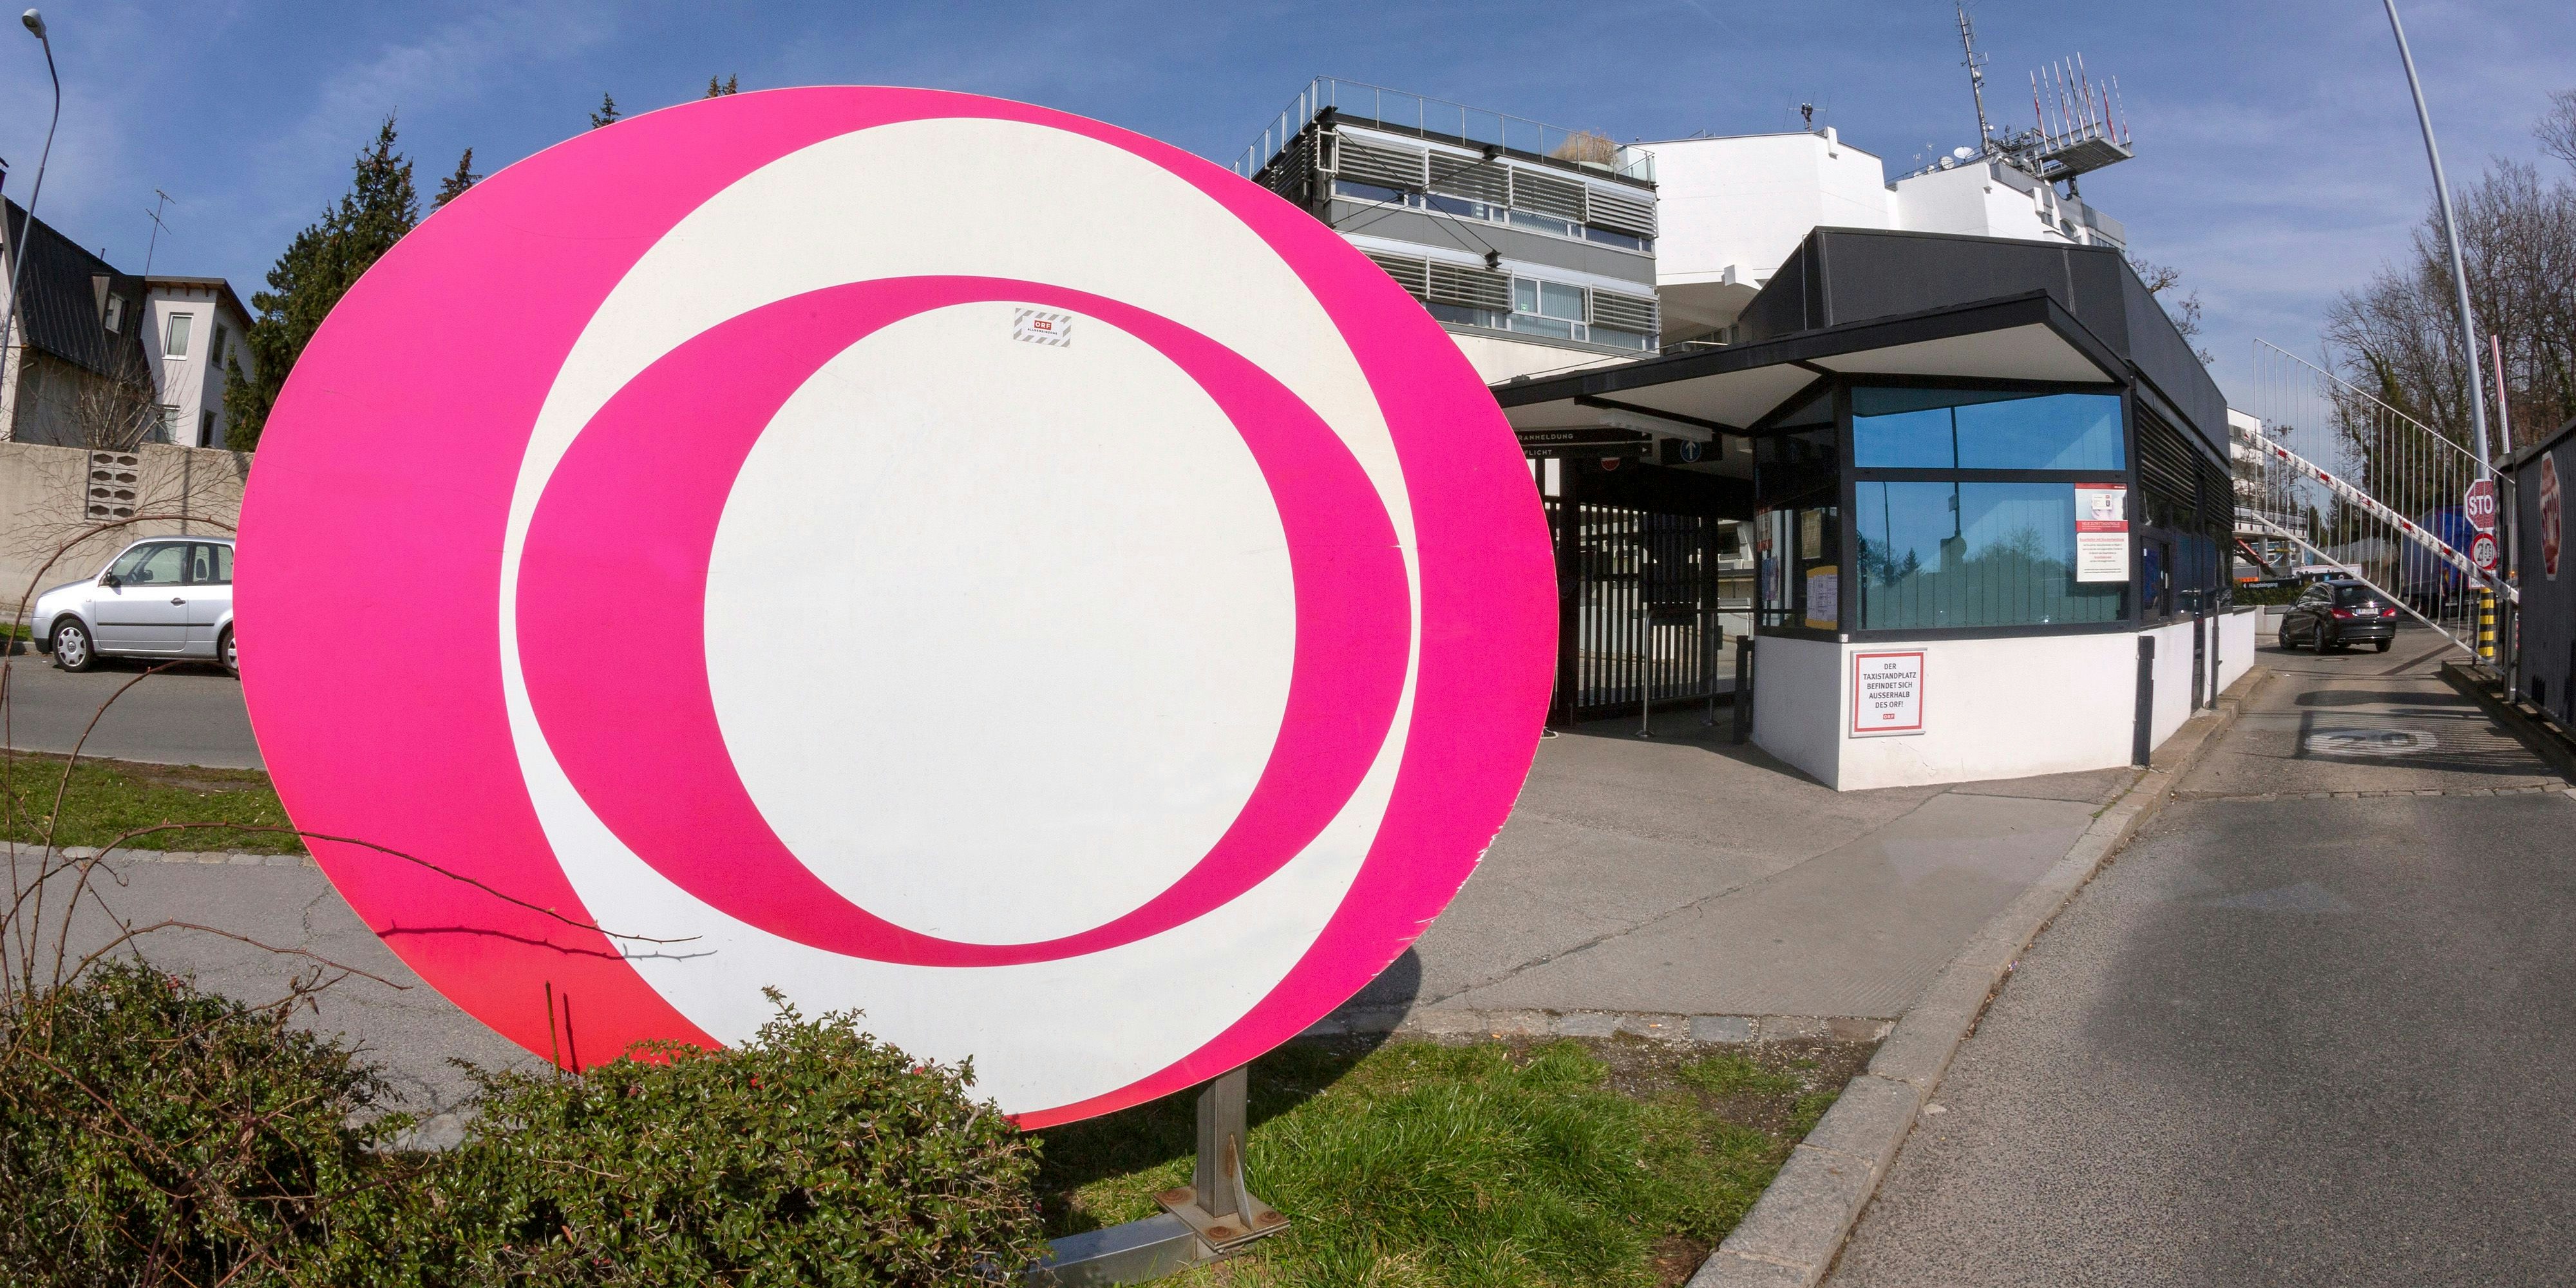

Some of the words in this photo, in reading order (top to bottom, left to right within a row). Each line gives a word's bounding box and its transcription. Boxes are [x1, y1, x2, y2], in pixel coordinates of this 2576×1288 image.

[2469, 495, 2493, 515] STO
[2477, 542, 2492, 562] 20
[1863, 672, 1917, 680] TAXISTANDPLATZ
